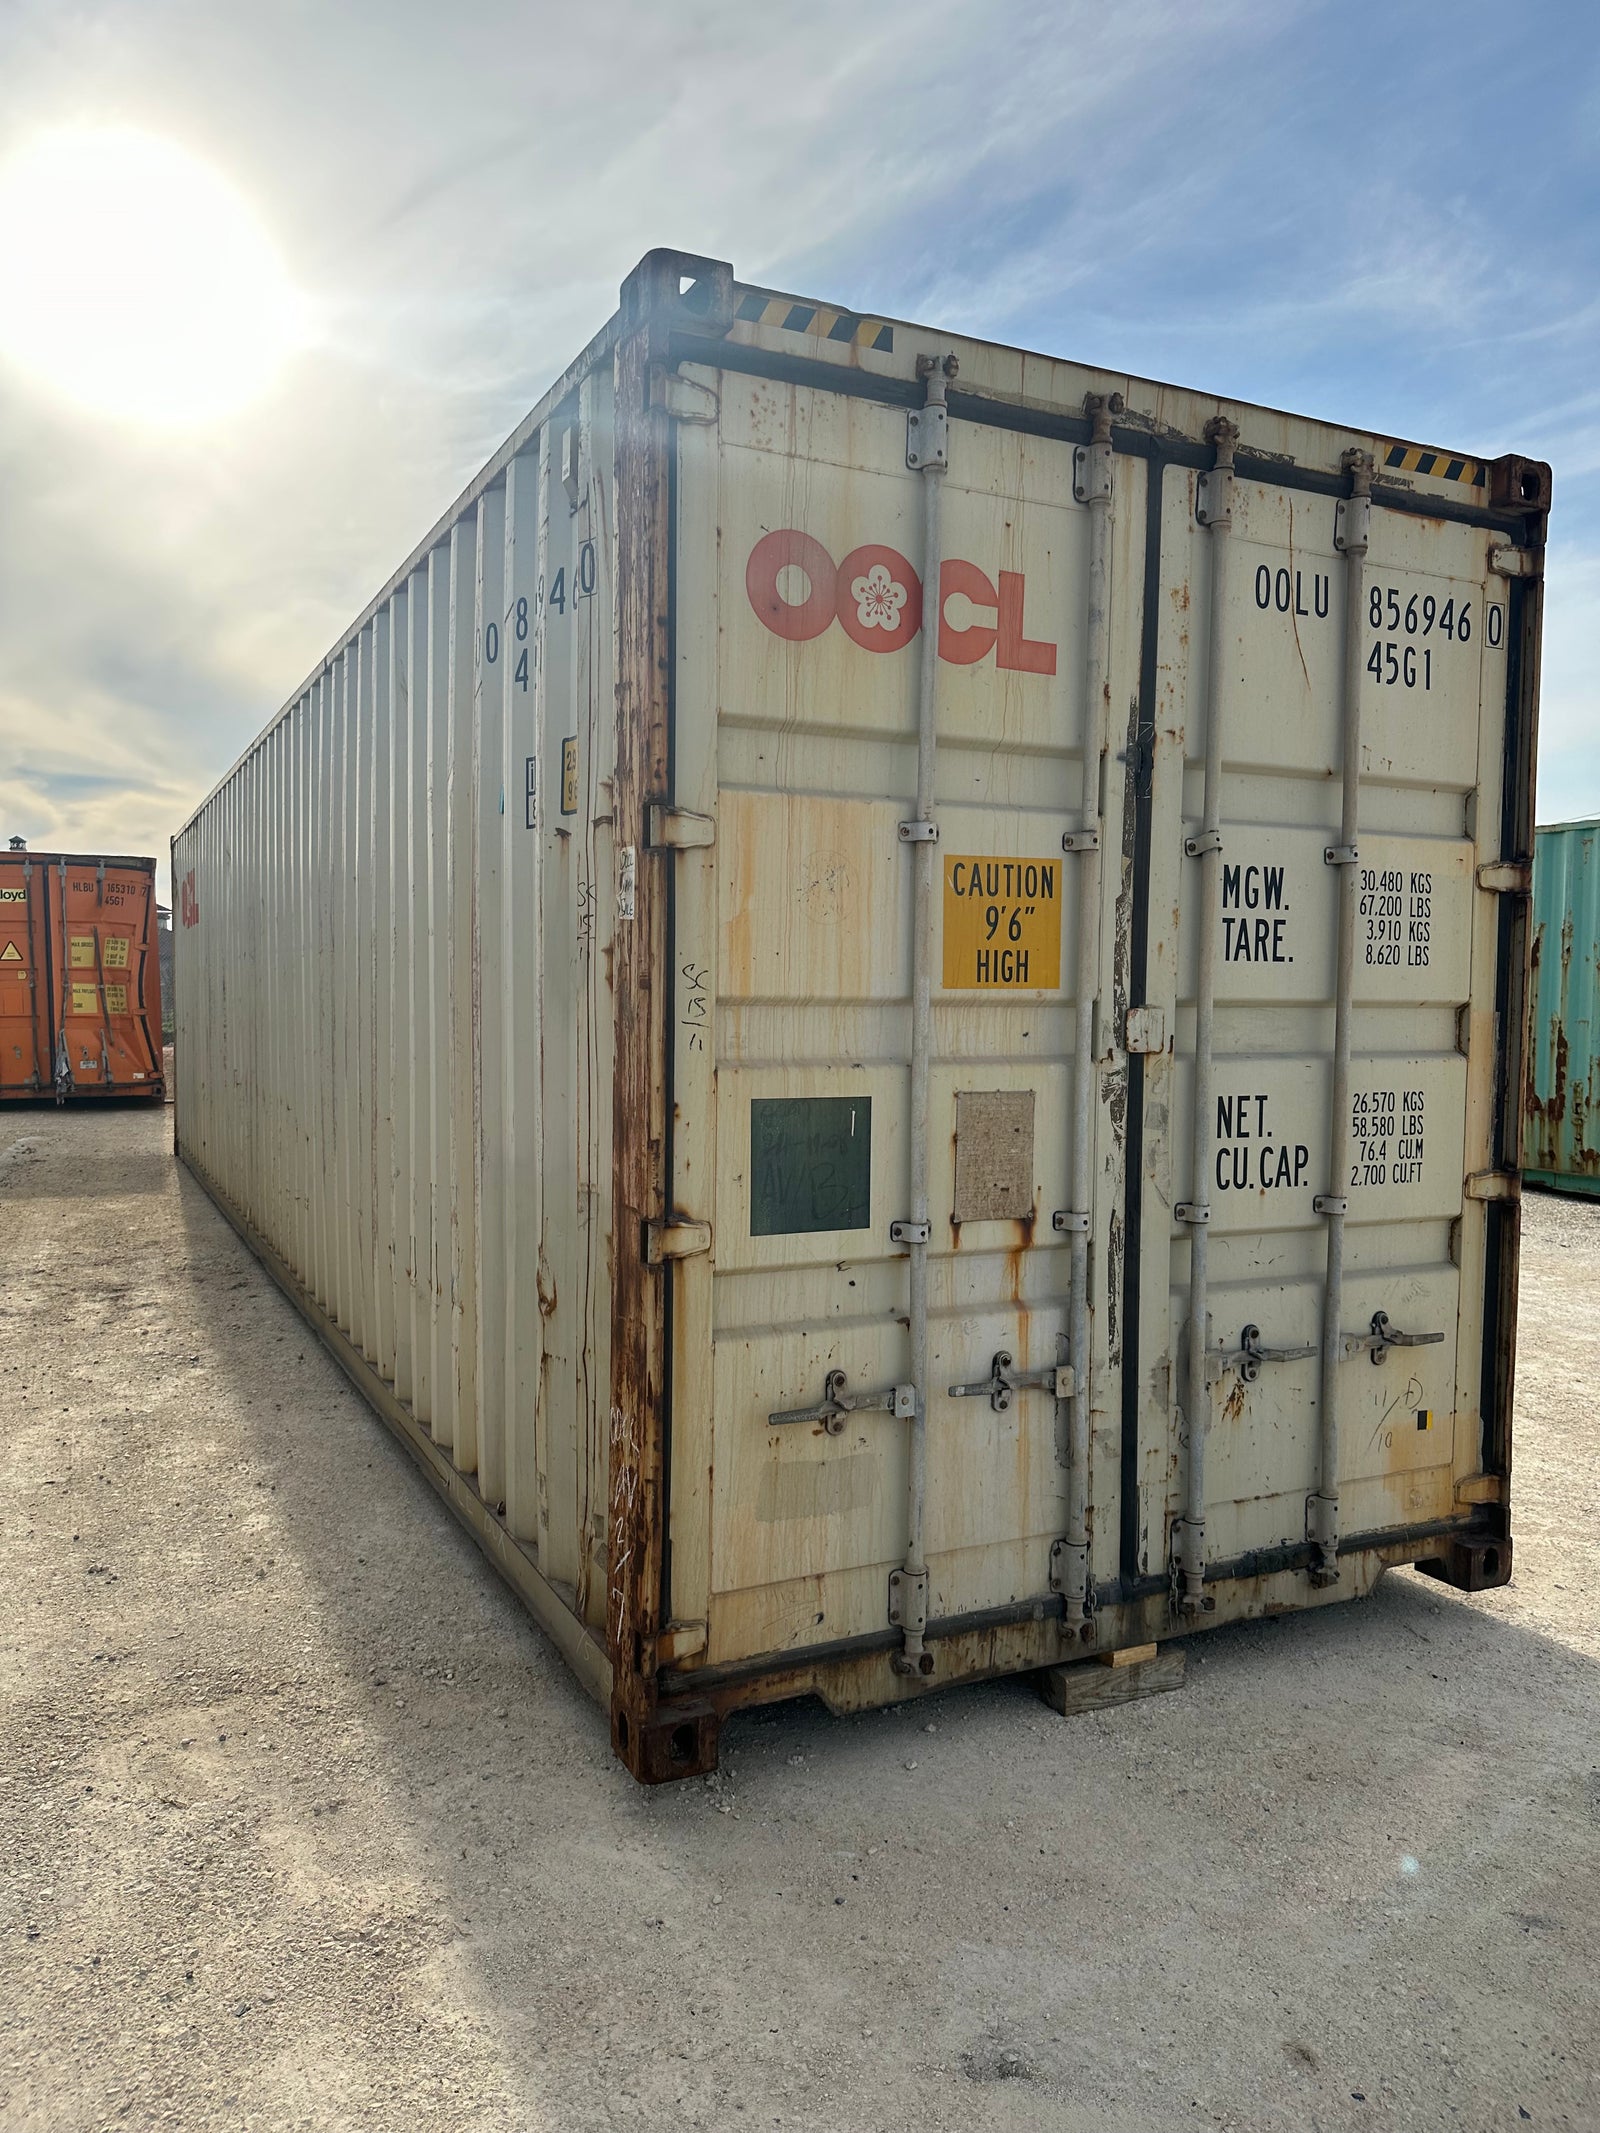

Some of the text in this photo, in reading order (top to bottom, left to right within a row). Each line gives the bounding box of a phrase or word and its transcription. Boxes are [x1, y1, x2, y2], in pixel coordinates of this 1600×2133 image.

[580, 543, 595, 594] 0
[746, 529, 1057, 675] OOCL
[1255, 565, 1501, 646] OOLU 856946 0
[1367, 641, 1431, 690] 45G1
[953, 862, 1053, 898] CAUTION
[1222, 864, 1289, 910] MGW.
[1360, 870, 1432, 894] 30,480 KGS
[0, 889, 26, 901] loyd
[1359, 895, 1431, 918] 67,200 LBS
[1222, 918, 1294, 962] TARE.
[1366, 920, 1431, 942] 3,910 KGS
[976, 949, 1029, 982] HIGH
[1365, 944, 1429, 966] 8,620 LBS
[1352, 1091, 1424, 1113] 26,570 KGS
[1216, 1095, 1272, 1138] NET.
[1352, 1115, 1424, 1137] 58,580 LBS
[1359, 1139, 1423, 1162] 76.4 CU.M
[1350, 1162, 1423, 1186] 2,700 CU.FT
